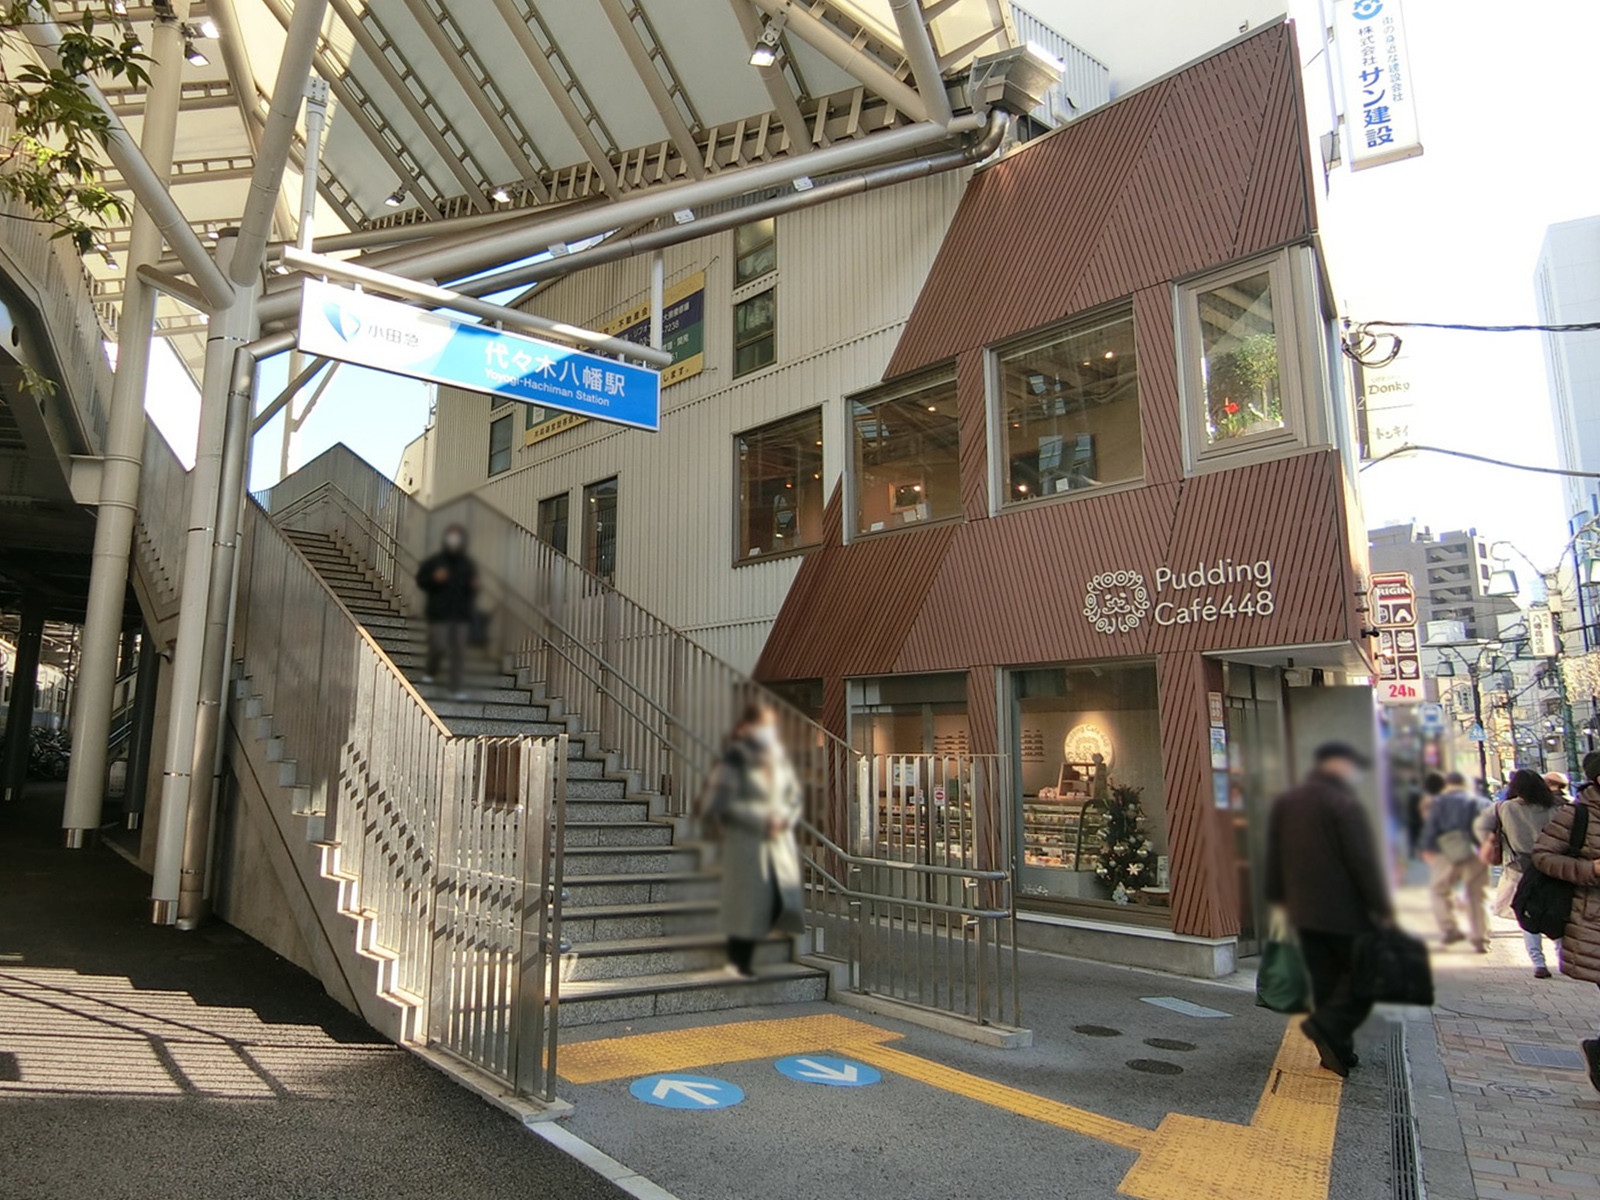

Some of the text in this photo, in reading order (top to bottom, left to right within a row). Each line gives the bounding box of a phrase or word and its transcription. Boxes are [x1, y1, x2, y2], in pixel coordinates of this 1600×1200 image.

[368, 325, 419, 348] 小田急
[485, 340, 625, 397] 代々木八幡駅
[484, 368, 610, 407] Yoyogi-Hachiman Station
[1155, 558, 1273, 592] Pudding
[1388, 684, 1416, 698] 24h
